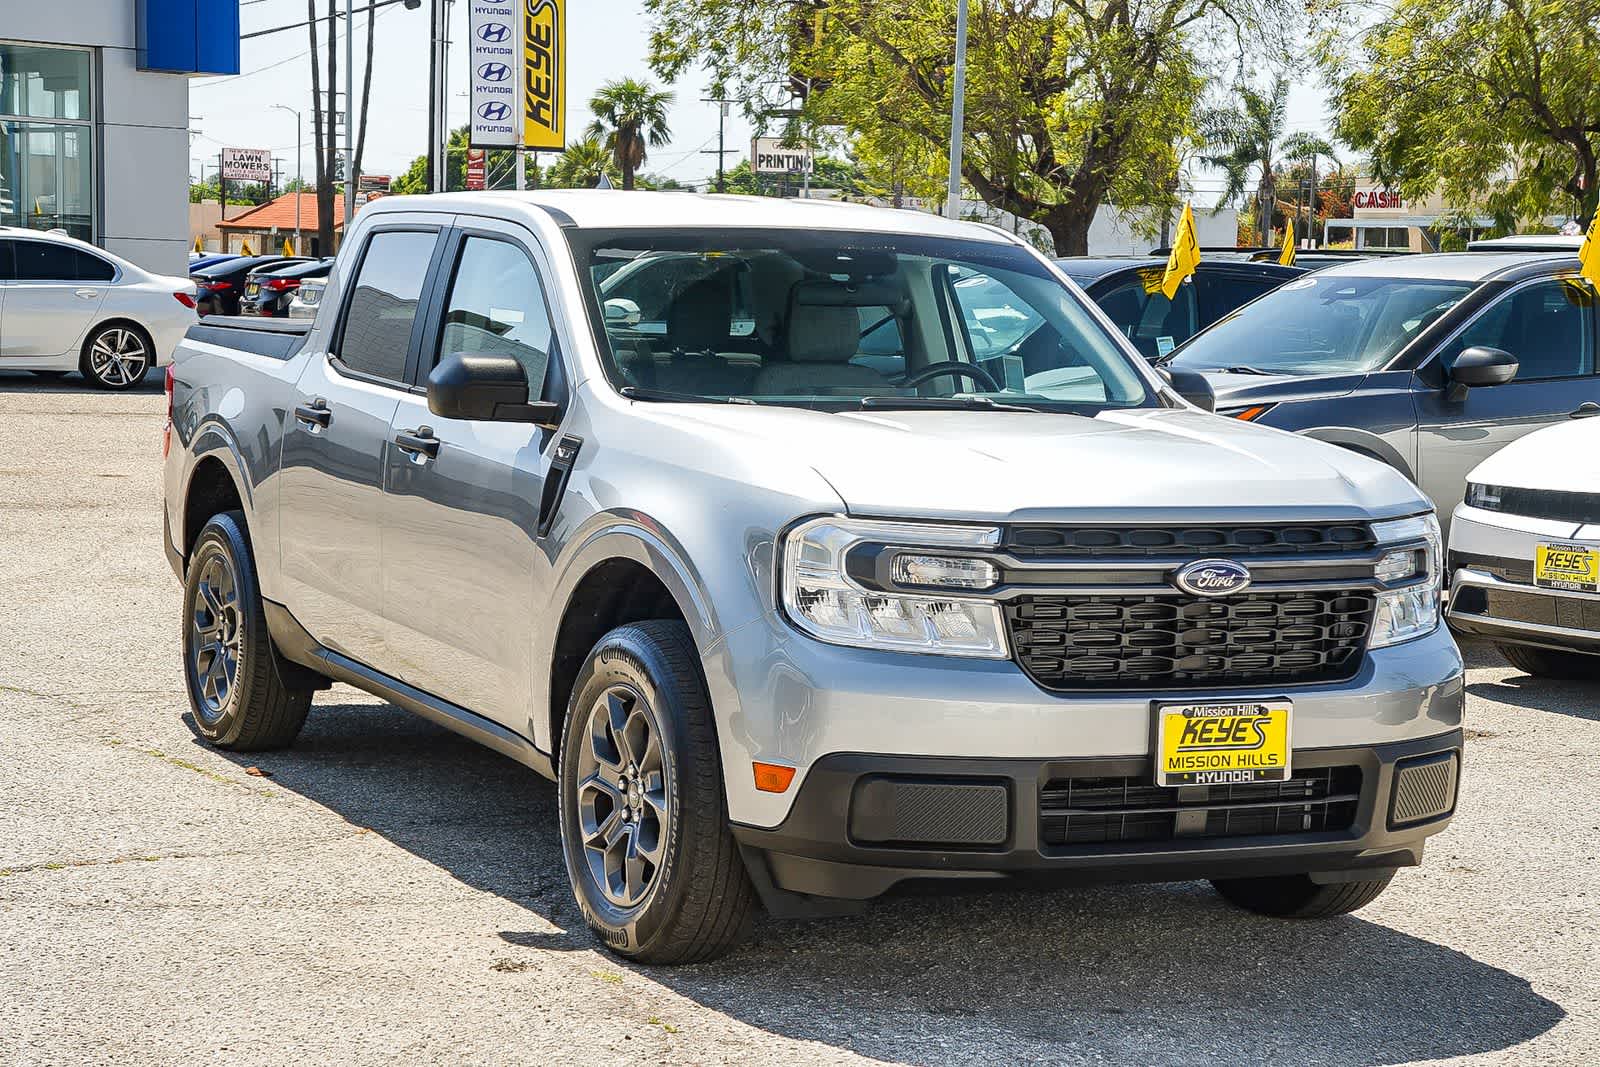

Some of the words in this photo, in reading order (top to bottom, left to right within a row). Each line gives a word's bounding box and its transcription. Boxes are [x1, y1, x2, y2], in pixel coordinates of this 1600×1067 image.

[475, 7, 512, 15] HYUNDAI
[476, 47, 513, 55] HYUNDAI
[476, 86, 513, 94] HYUNDAI
[476, 125, 513, 133] HYUNDAI
[232, 153, 262, 162] LAWN
[758, 154, 811, 168] PRINTING
[224, 161, 269, 171] MOWERS
[1355, 191, 1400, 208] CASH
[1544, 552, 1593, 575] KEYES
[1197, 569, 1236, 587] Ford
[1194, 706, 1234, 717] Mission
[1236, 704, 1260, 716] Hills
[1177, 717, 1272, 752] KEYES
[1168, 755, 1231, 769] MISSION
[1237, 753, 1278, 767] HILLS
[1196, 770, 1255, 784] HYUNDAI
